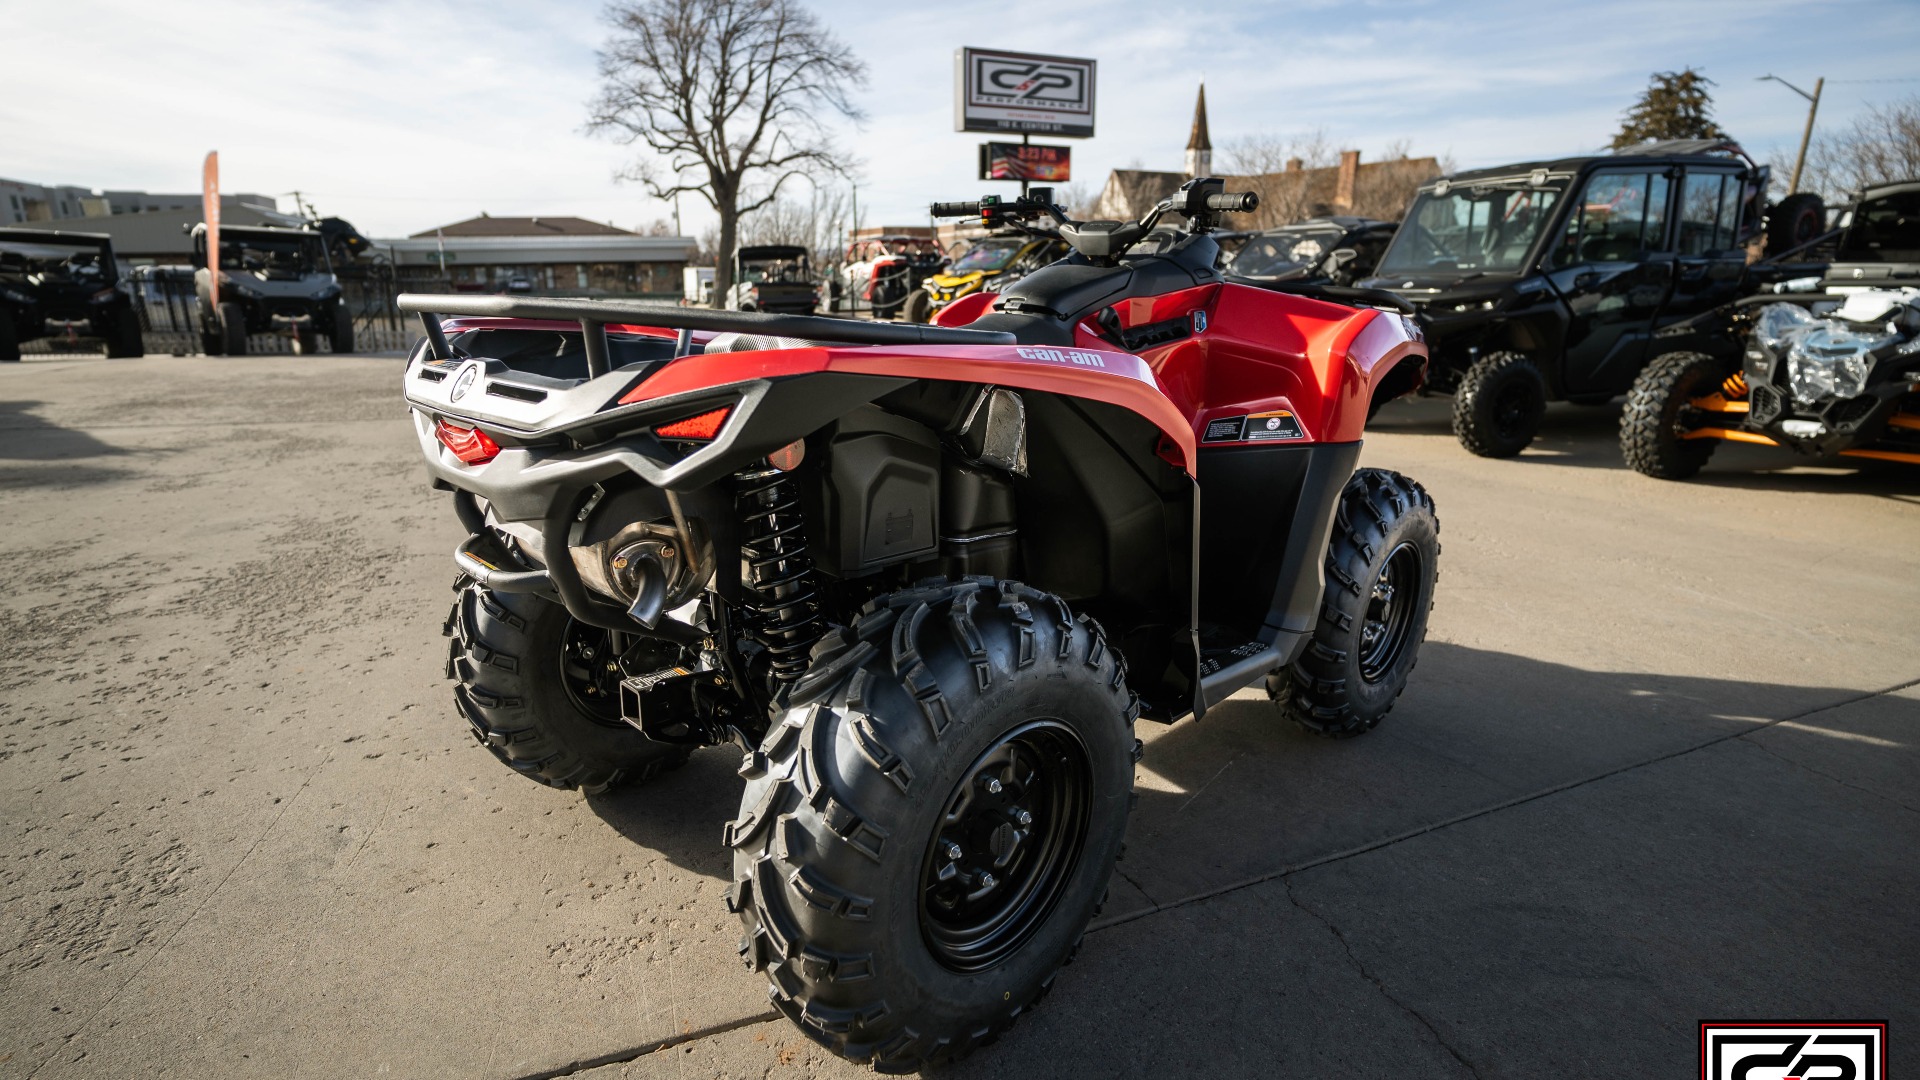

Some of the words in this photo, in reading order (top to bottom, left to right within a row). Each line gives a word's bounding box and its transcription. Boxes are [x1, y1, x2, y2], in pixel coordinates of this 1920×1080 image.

[975, 95, 1084, 109] PERFORMANCE
[1021, 121, 1050, 130] CENTER
[1041, 147, 1057, 160] PM
[1016, 347, 1105, 367] can-am
